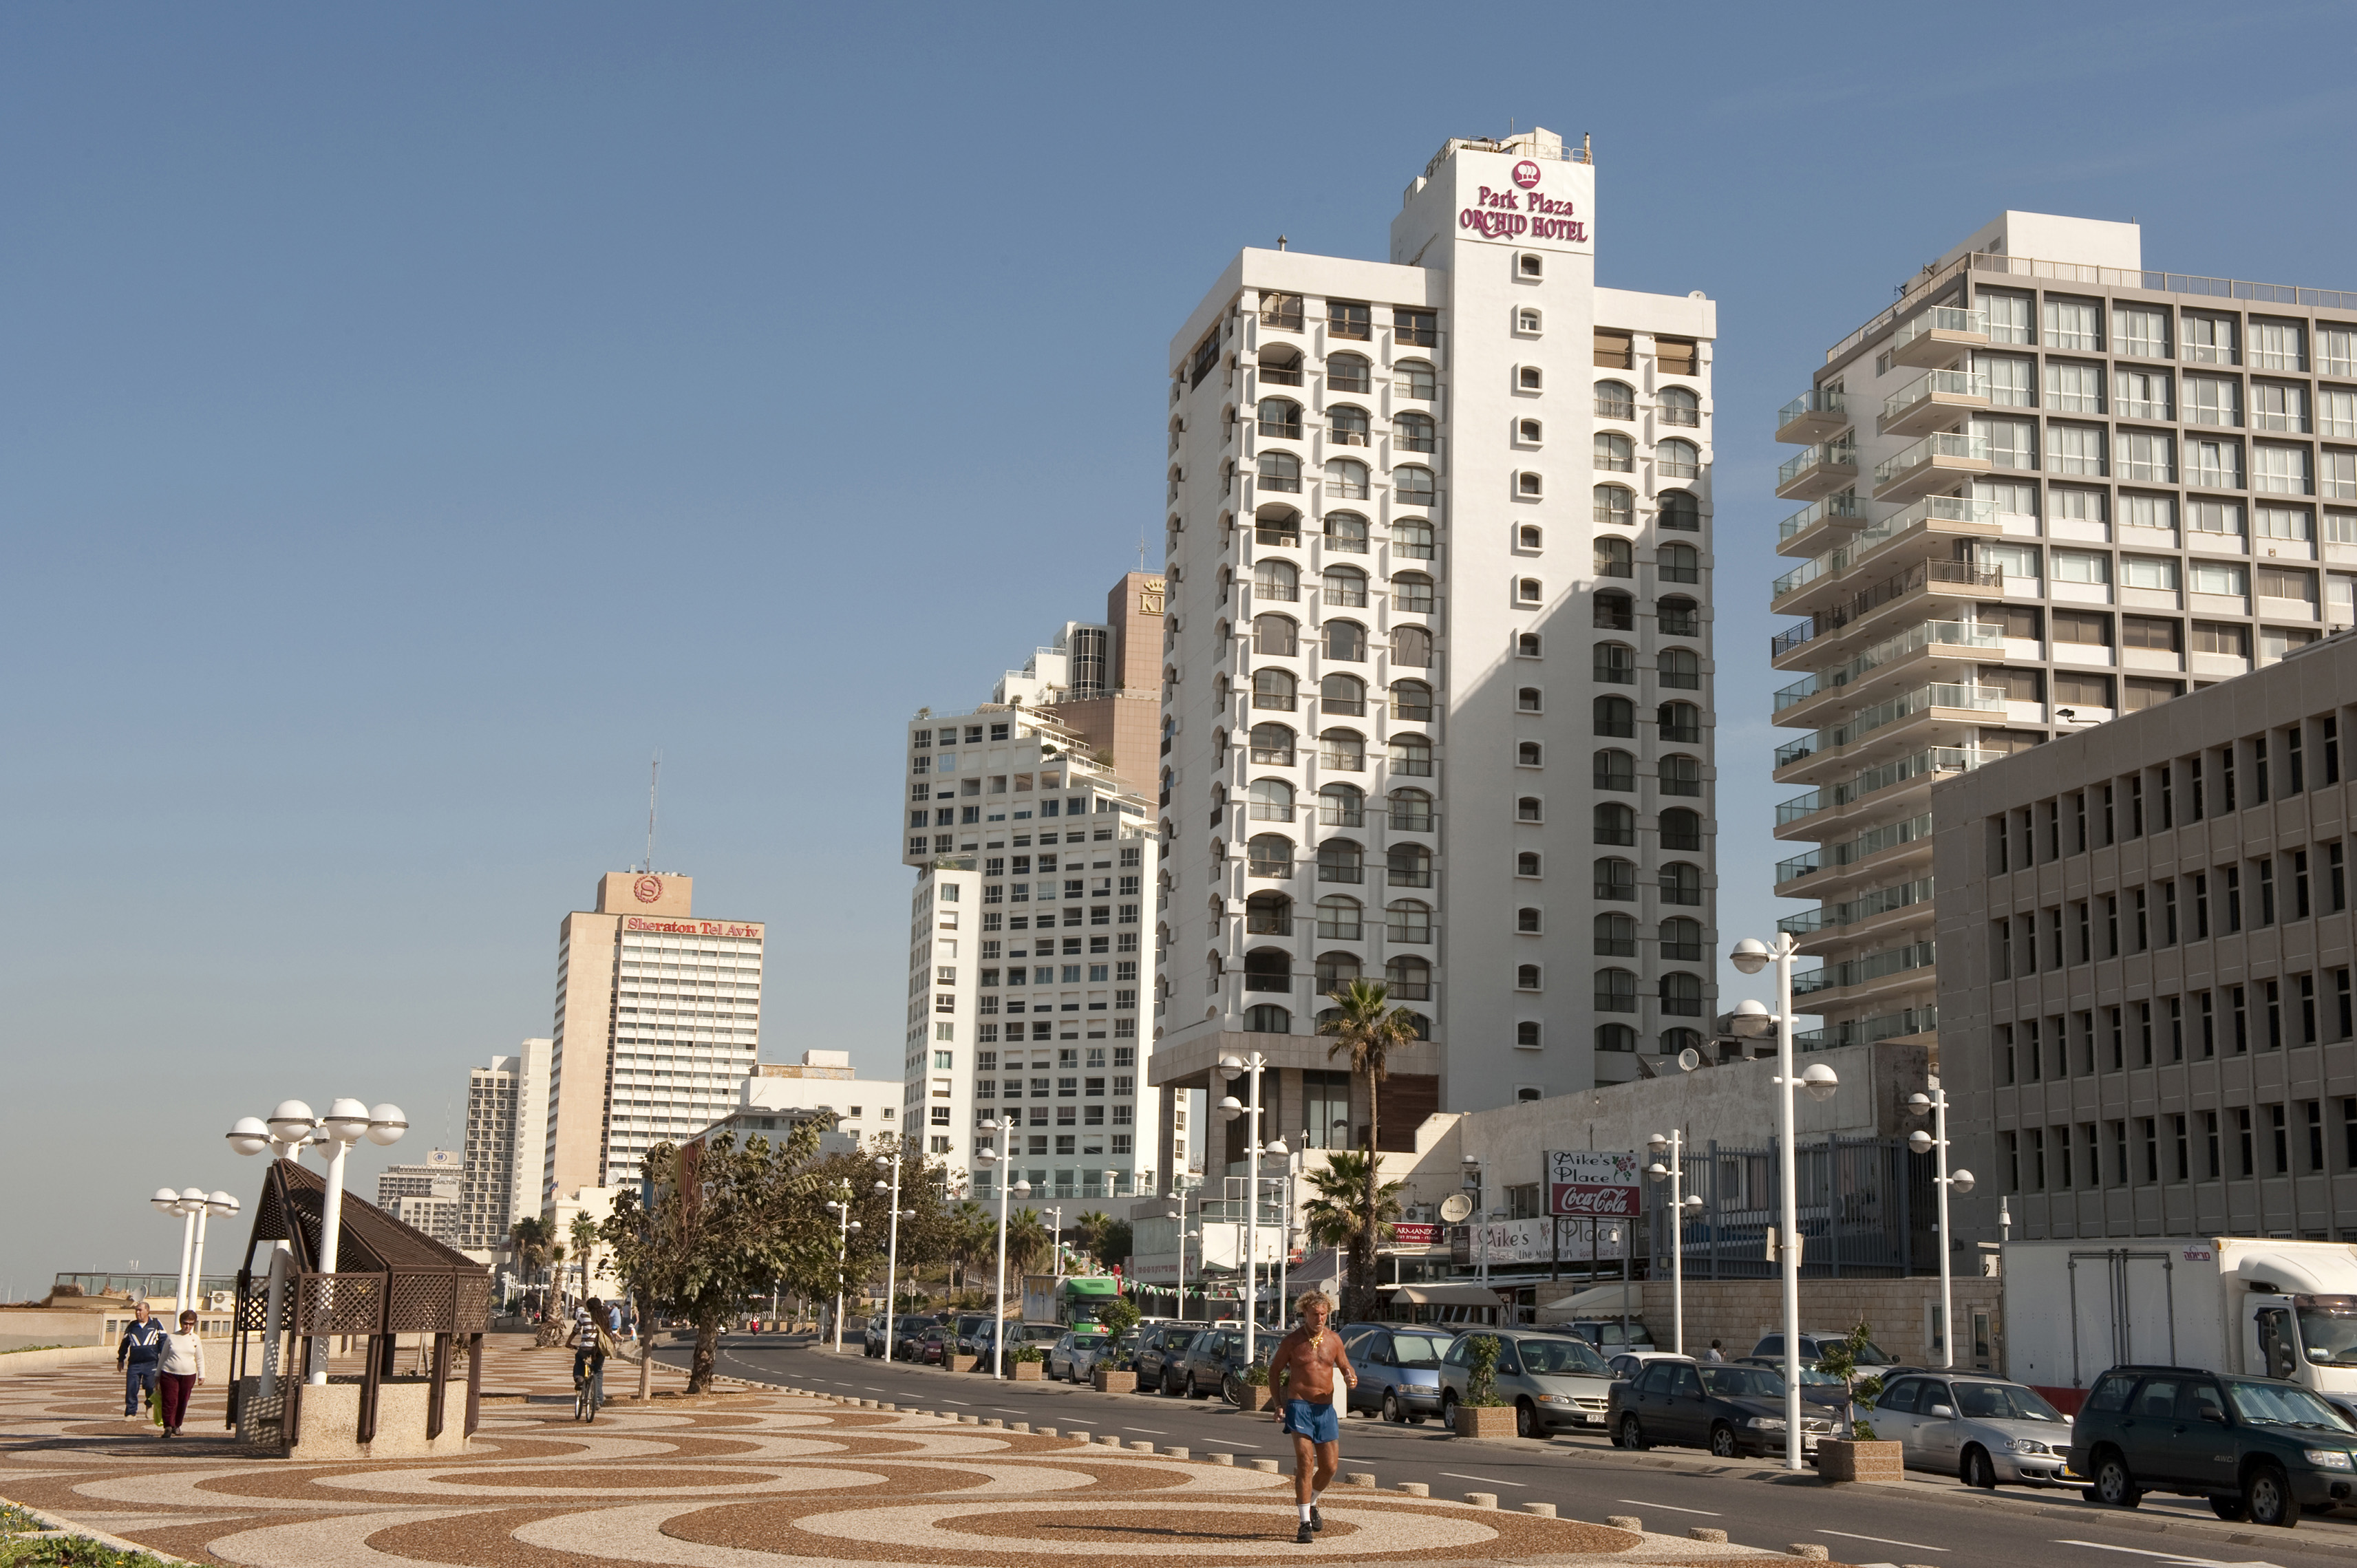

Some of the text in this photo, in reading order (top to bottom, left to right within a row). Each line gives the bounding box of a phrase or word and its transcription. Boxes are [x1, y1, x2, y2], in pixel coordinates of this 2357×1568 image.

[1478, 186, 1574, 215] Park Plaza
[1460, 208, 1588, 241] ORCHID HOTEL
[628, 917, 758, 937] Sheraton Tel Aviv
[1553, 1152, 1610, 1166] Mike's
[1553, 1166, 1610, 1183] Place
[1561, 1186, 1630, 1213] Coca-Cola
[1396, 1227, 1438, 1236] ARMANDO
[1478, 1224, 1529, 1248] Mike's
[1519, 1249, 1532, 1259] Live
[1599, 1247, 1609, 1256] Bar
[1177, 1256, 1195, 1276] FC
